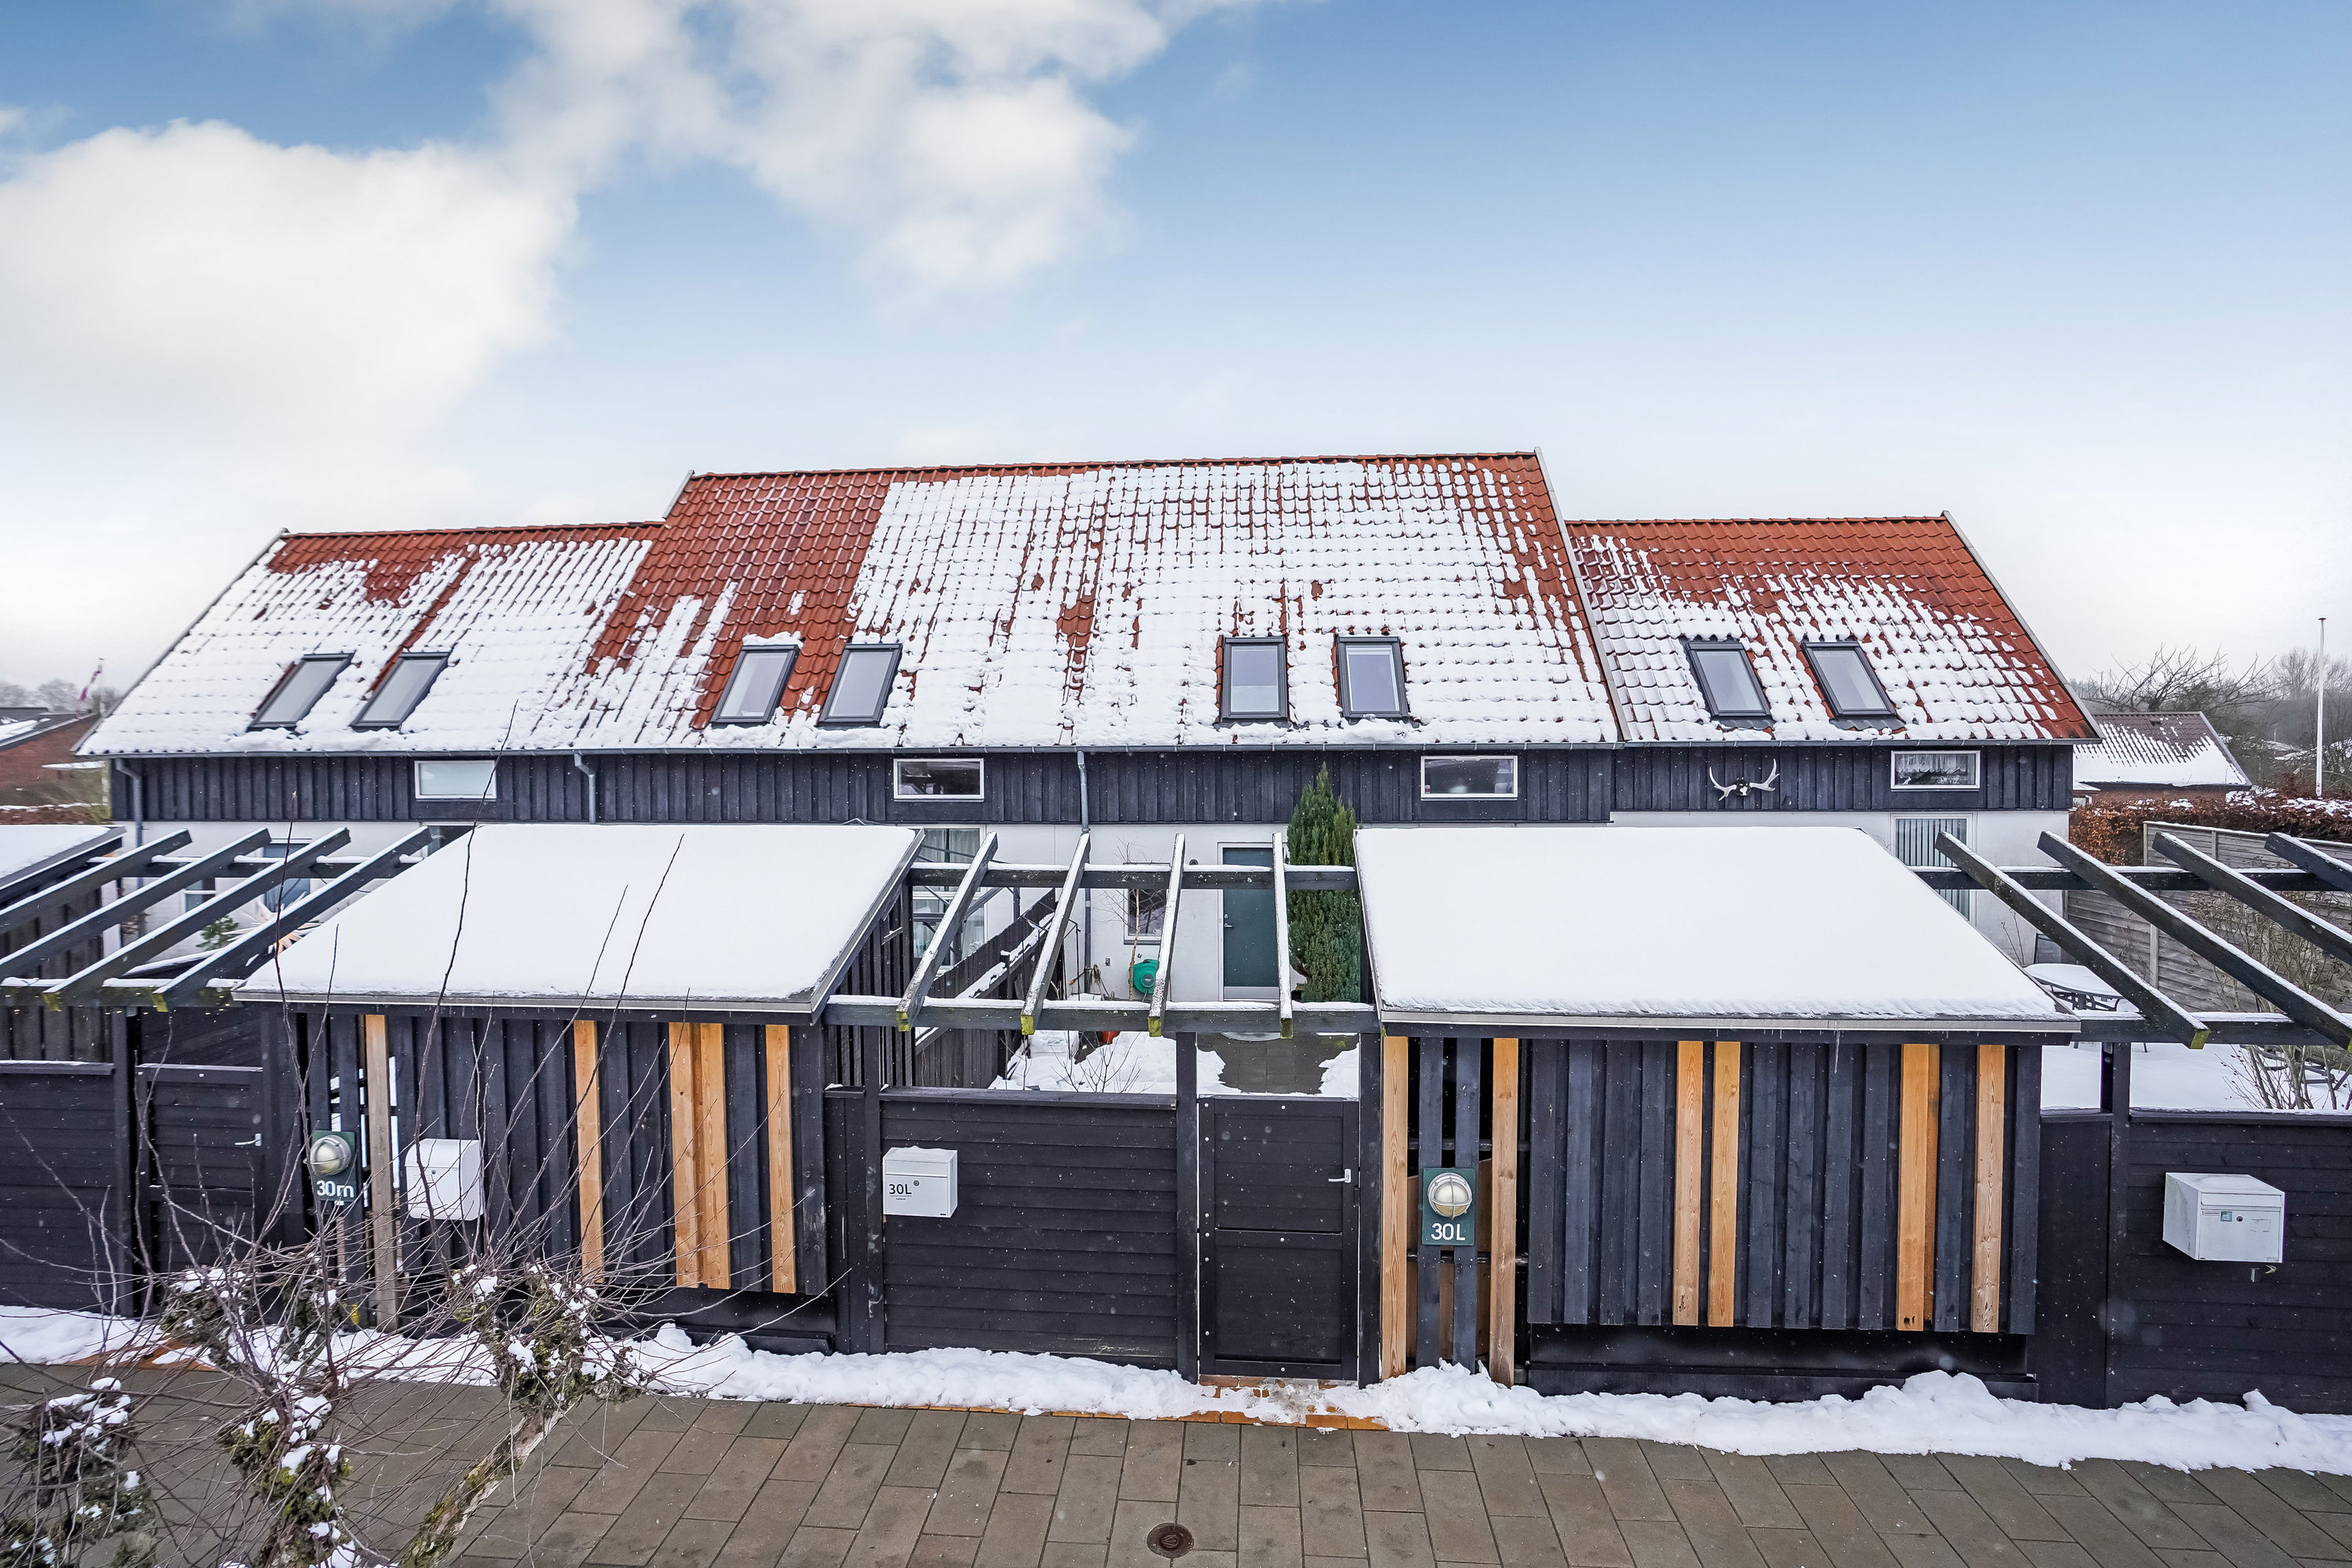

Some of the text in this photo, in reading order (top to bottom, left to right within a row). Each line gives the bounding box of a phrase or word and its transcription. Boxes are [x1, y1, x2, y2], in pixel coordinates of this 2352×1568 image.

[316, 1180, 355, 1198] 30m
[888, 1184, 912, 1195] 30L
[1431, 1222, 1466, 1240] 30L
